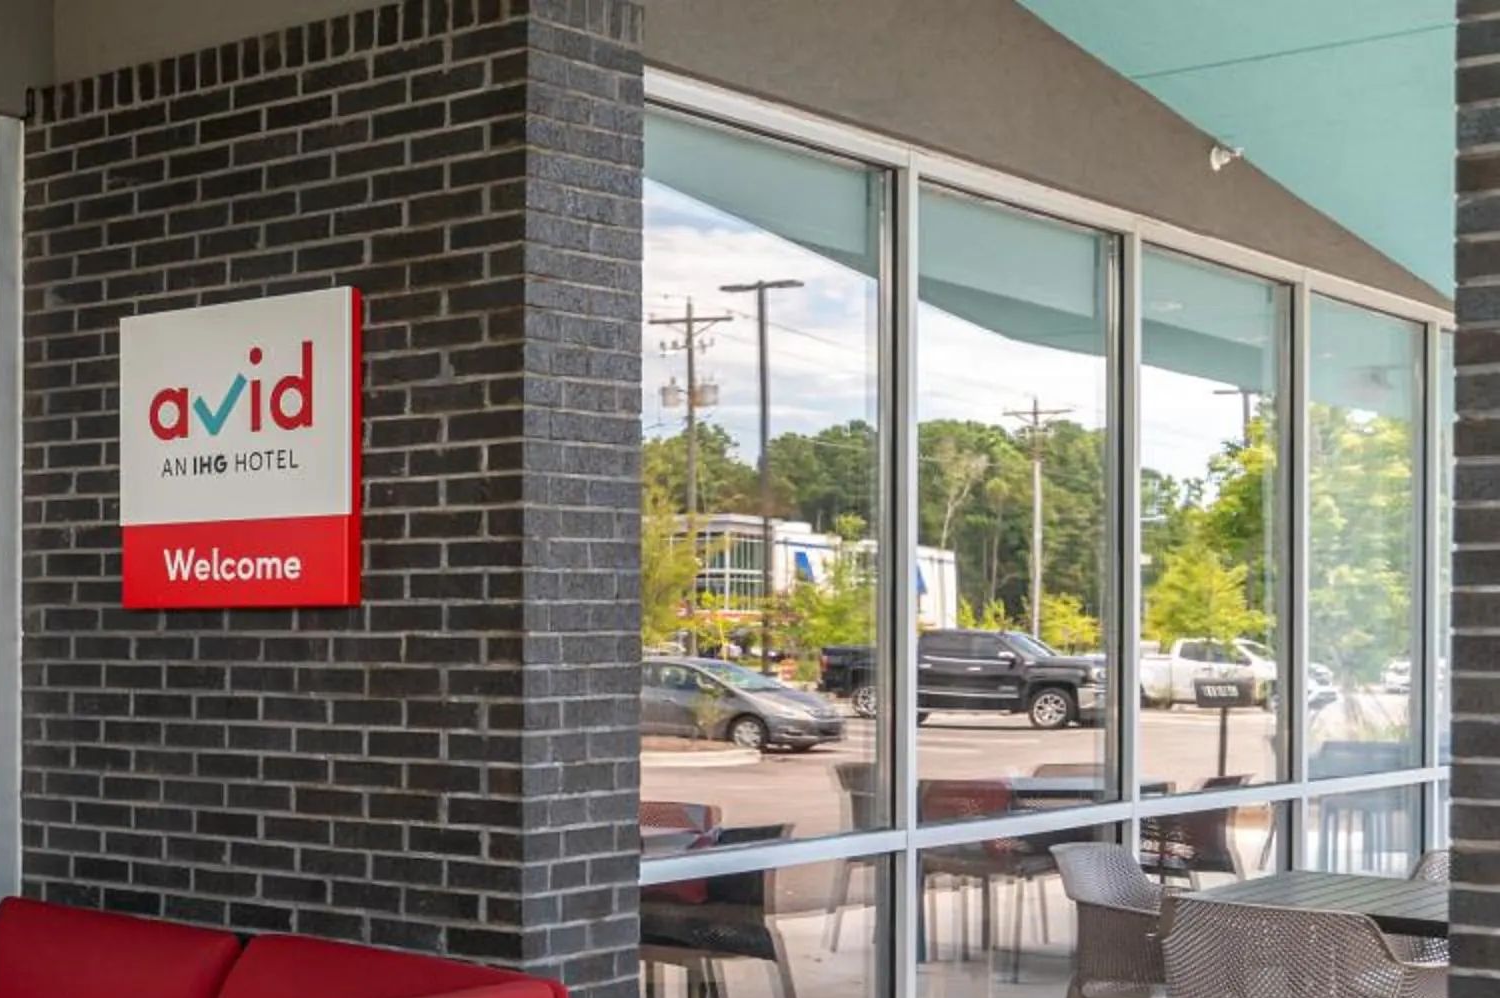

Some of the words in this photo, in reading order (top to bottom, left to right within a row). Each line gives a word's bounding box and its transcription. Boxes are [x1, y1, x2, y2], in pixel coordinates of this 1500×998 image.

[149, 340, 313, 441] avid
[161, 457, 187, 477] AN
[192, 454, 228, 475] IHG
[235, 450, 300, 472] HOTEL
[163, 547, 302, 582] Welcome
